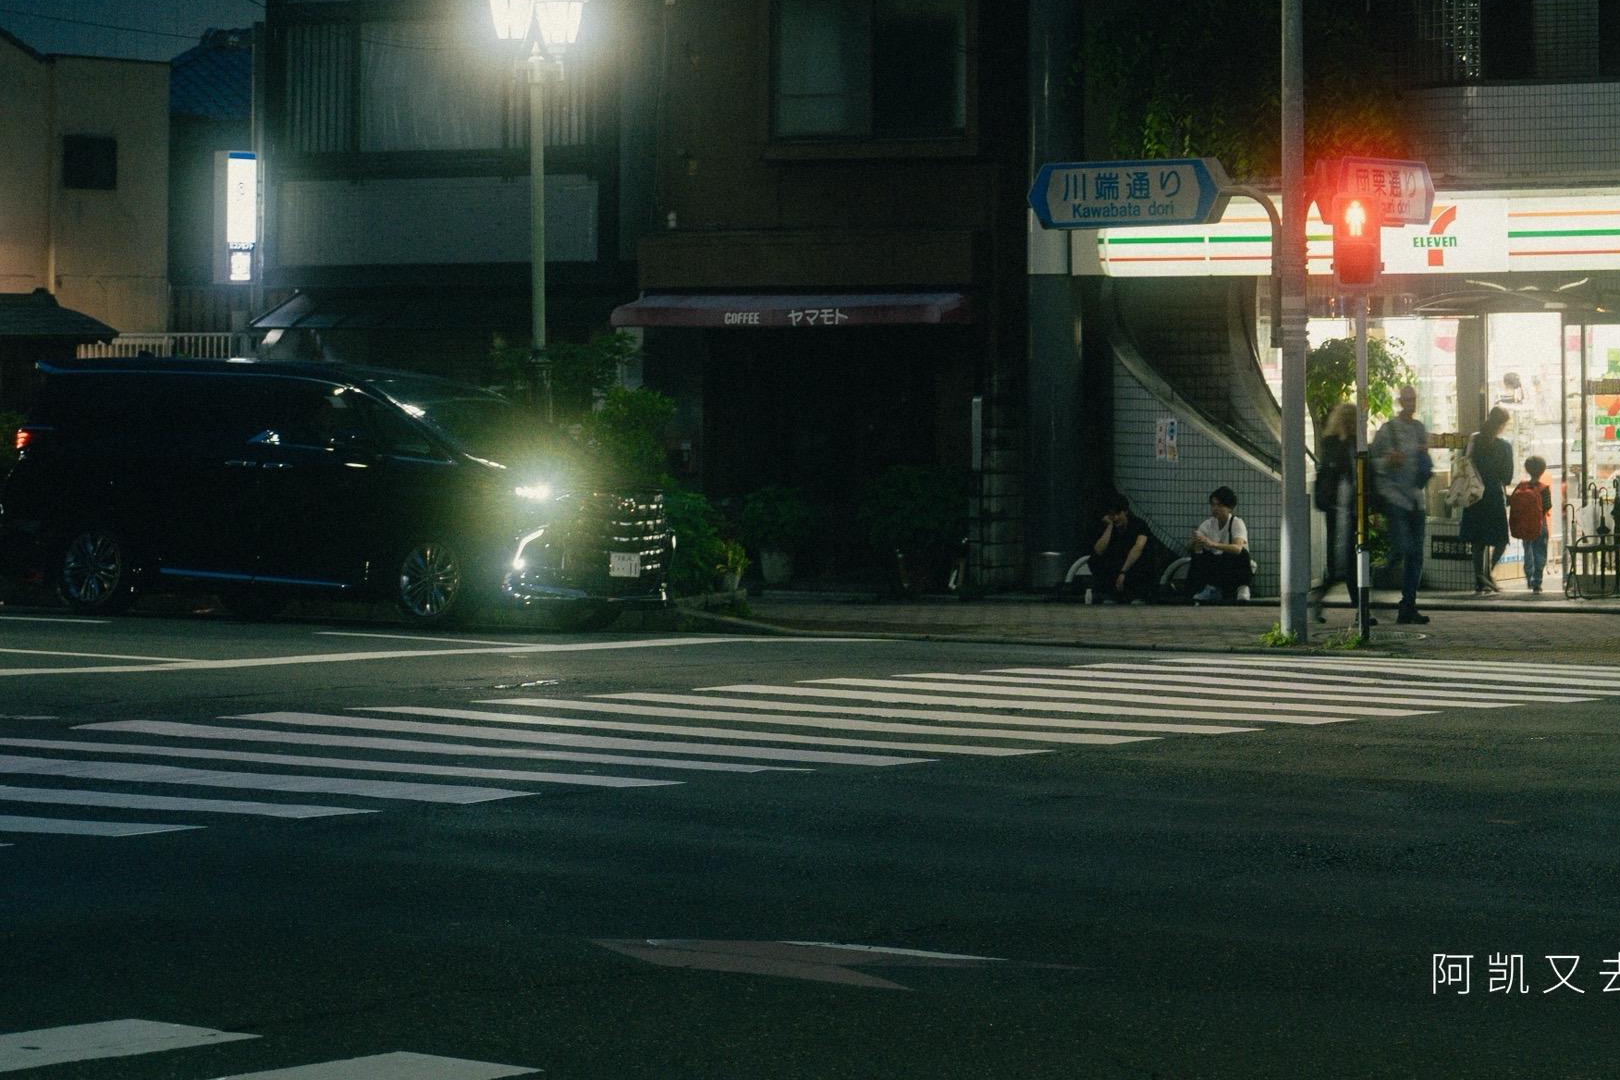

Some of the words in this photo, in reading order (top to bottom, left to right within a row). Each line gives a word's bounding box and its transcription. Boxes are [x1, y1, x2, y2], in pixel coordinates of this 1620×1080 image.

[1063, 171, 1181, 201] 川端通り
[1072, 203, 1140, 219] Kawabata
[1148, 201, 1174, 216] dori
[724, 312, 760, 325] COFFEE
[788, 308, 849, 326] ヤマモト
